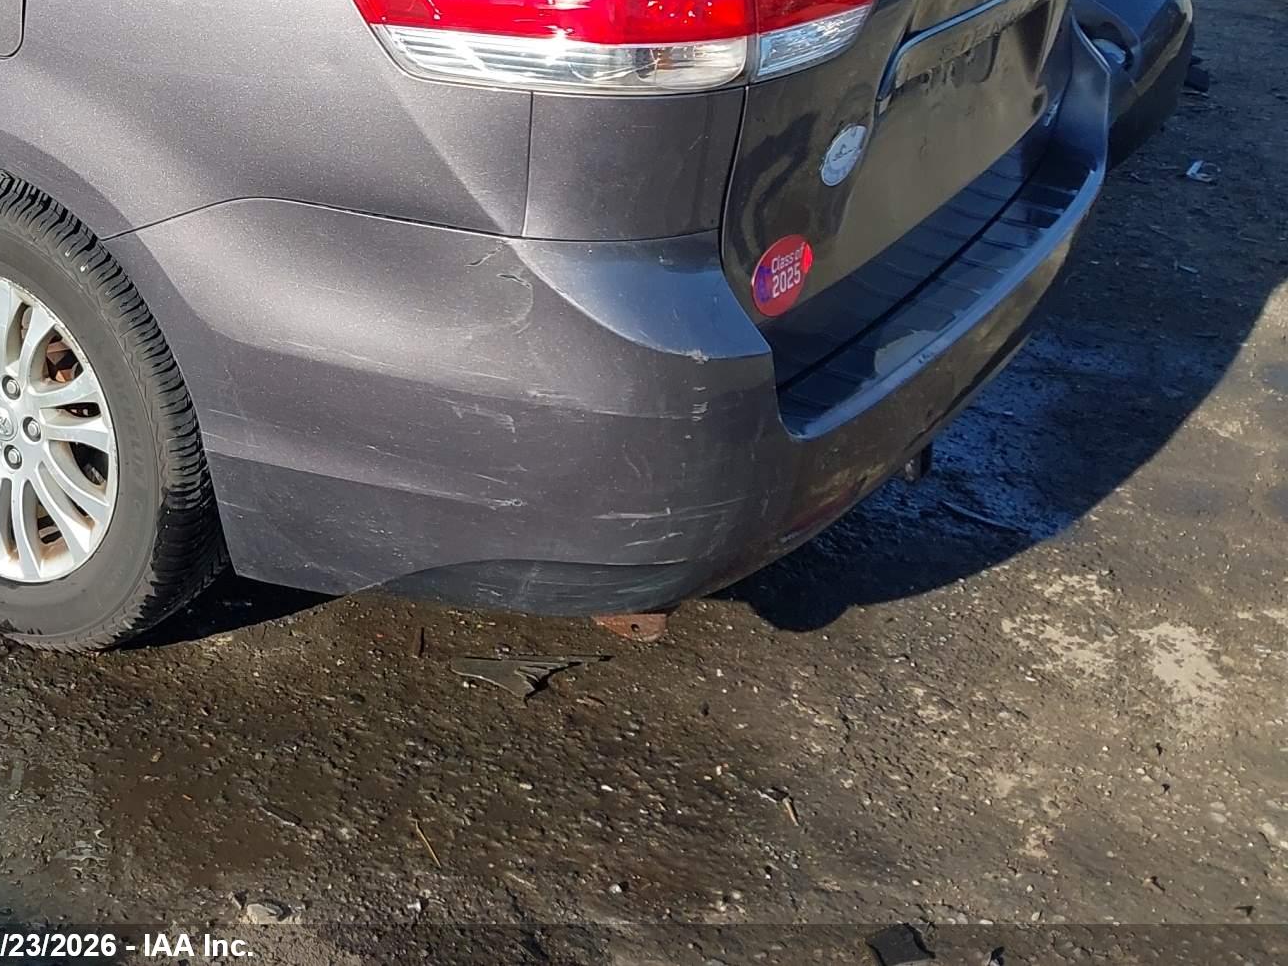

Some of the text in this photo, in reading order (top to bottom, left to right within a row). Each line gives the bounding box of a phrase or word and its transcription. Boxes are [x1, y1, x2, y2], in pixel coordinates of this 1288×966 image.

[771, 241, 806, 274] Class of
[772, 262, 801, 298] 2025
